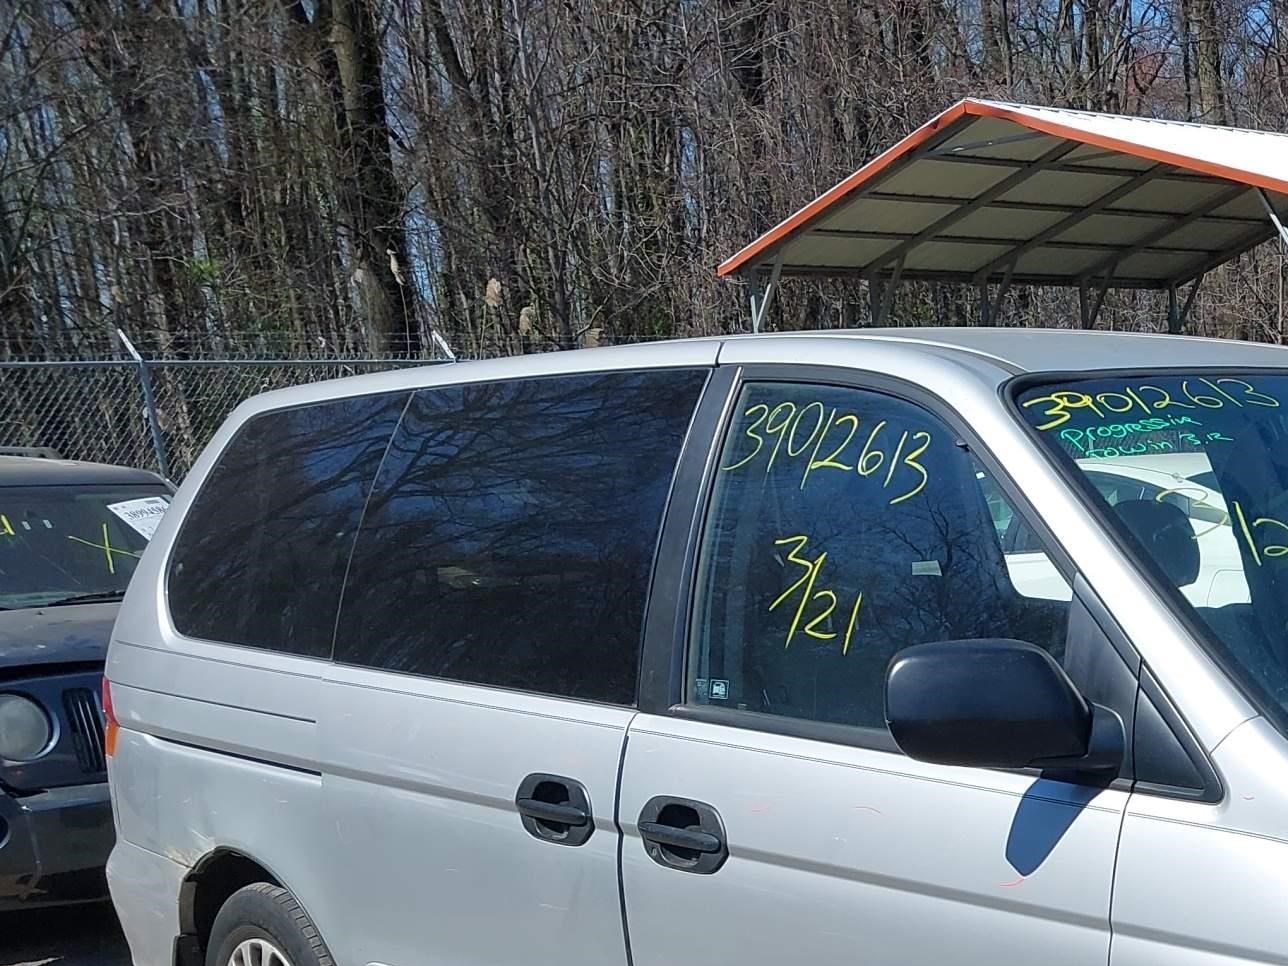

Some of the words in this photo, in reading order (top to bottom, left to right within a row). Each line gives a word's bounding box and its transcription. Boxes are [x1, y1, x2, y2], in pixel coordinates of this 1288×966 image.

[721, 401, 931, 505] 39012613
[1023, 377, 1280, 431] 39012613
[768, 535, 863, 656] 3/21
